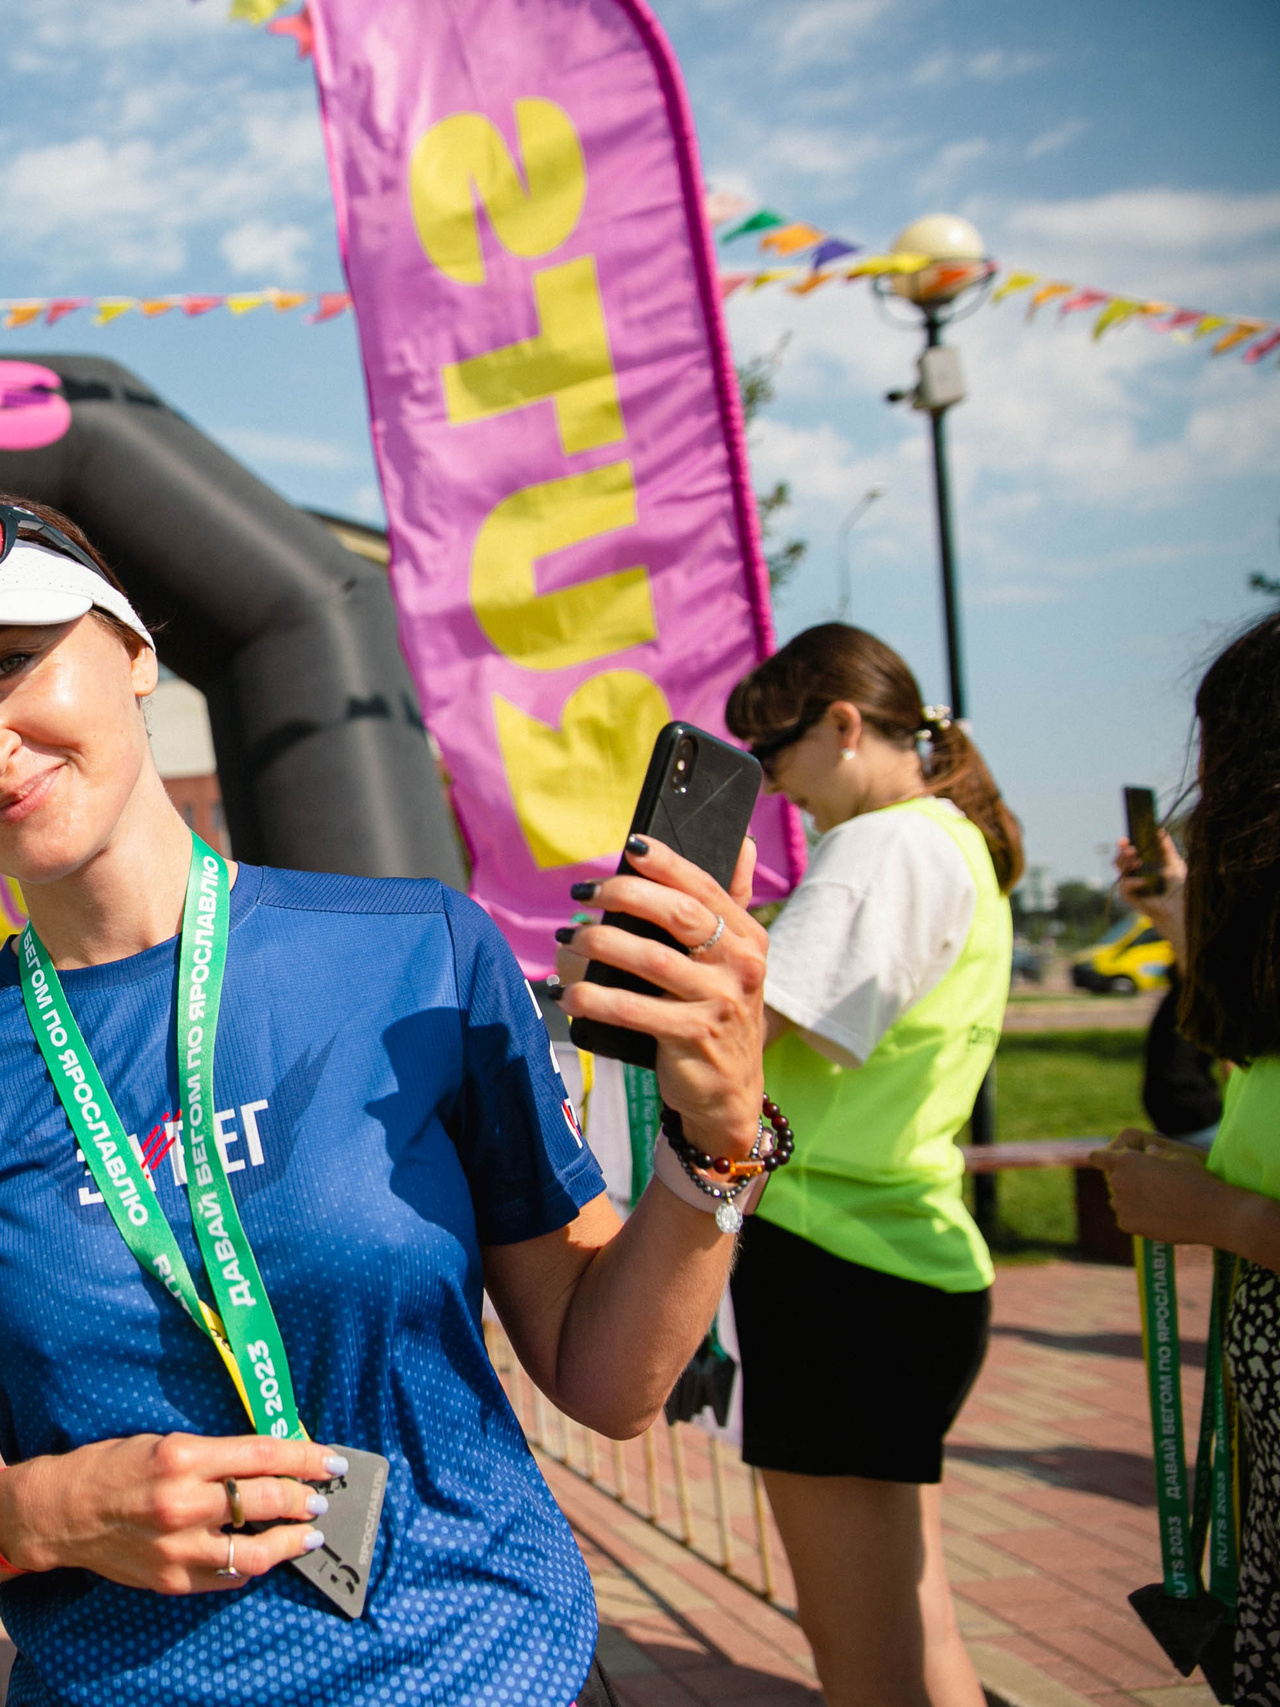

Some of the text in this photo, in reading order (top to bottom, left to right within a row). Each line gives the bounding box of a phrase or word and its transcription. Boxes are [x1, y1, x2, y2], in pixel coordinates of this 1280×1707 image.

[22, 928, 149, 1227] БЕГОМ ПО ЯРОСЛАВЛЮ
[186, 855, 257, 1308] ДАВАЙ БЕГОМ ПО ЯРОСЛАВЛЮ
[246, 1339, 284, 1417] 2023
[1152, 1239, 1182, 1500] ДАВАЙ БЕГОМ ПО ЯРОСЛАВЛ
[358, 1467, 386, 1567] ЯРОСЛАВЛЬ
[1167, 1515, 1188, 1599] UTS 2023
